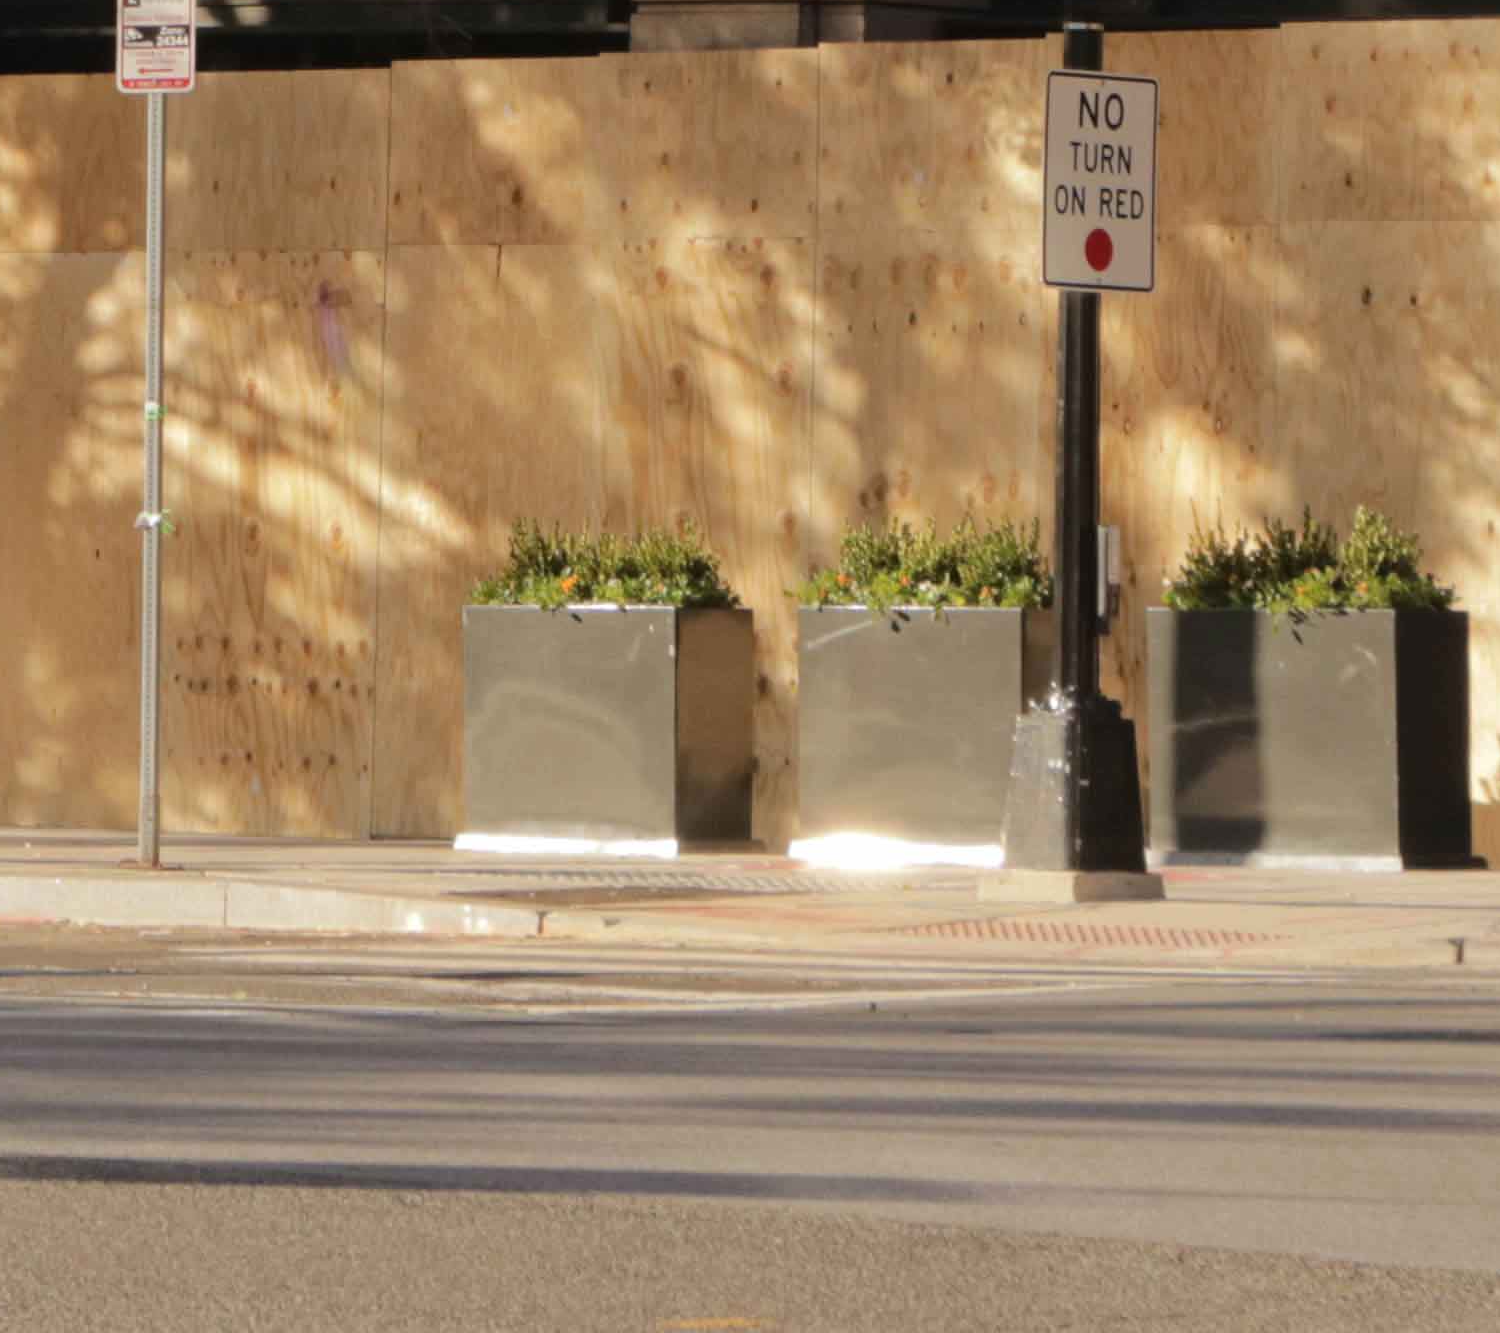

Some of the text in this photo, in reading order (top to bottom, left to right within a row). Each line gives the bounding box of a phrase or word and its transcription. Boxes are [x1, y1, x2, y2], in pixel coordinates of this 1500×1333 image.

[1079, 91, 1124, 130] NO
[1070, 141, 1132, 174] TURN
[1055, 185, 1144, 220] ON RED
